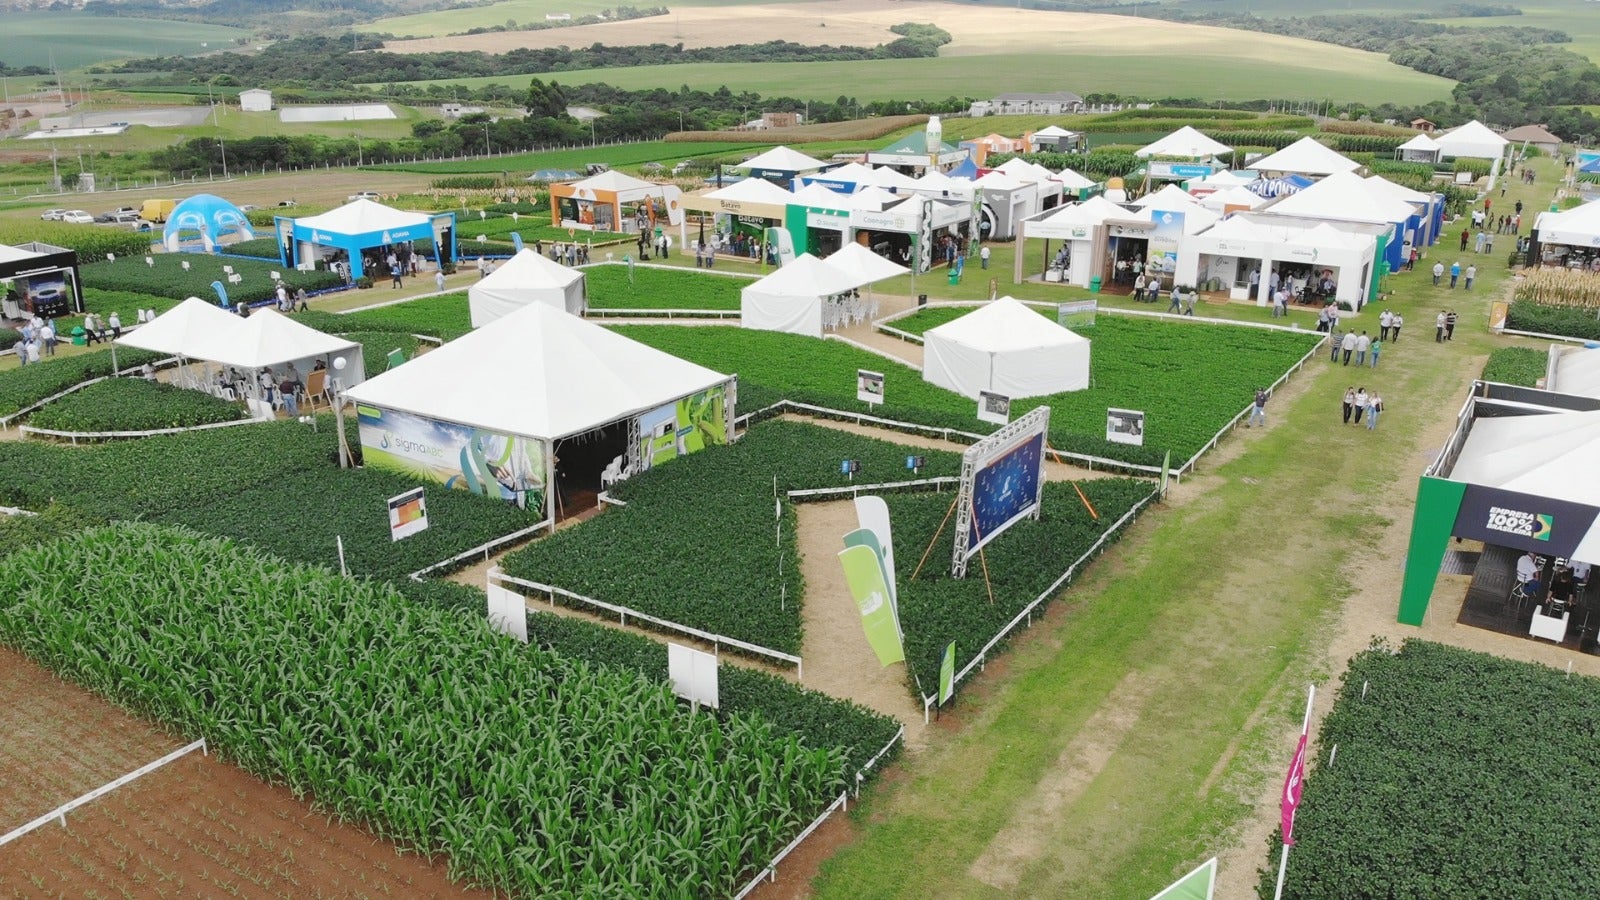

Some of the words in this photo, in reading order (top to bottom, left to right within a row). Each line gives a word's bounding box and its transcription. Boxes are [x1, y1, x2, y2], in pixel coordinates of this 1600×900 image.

[720, 200, 741, 209] Batavo
[1489, 507, 1534, 520] EMPRESA
[1487, 514, 1532, 531] 100%
[1485, 523, 1532, 537] BRASILEIRA
